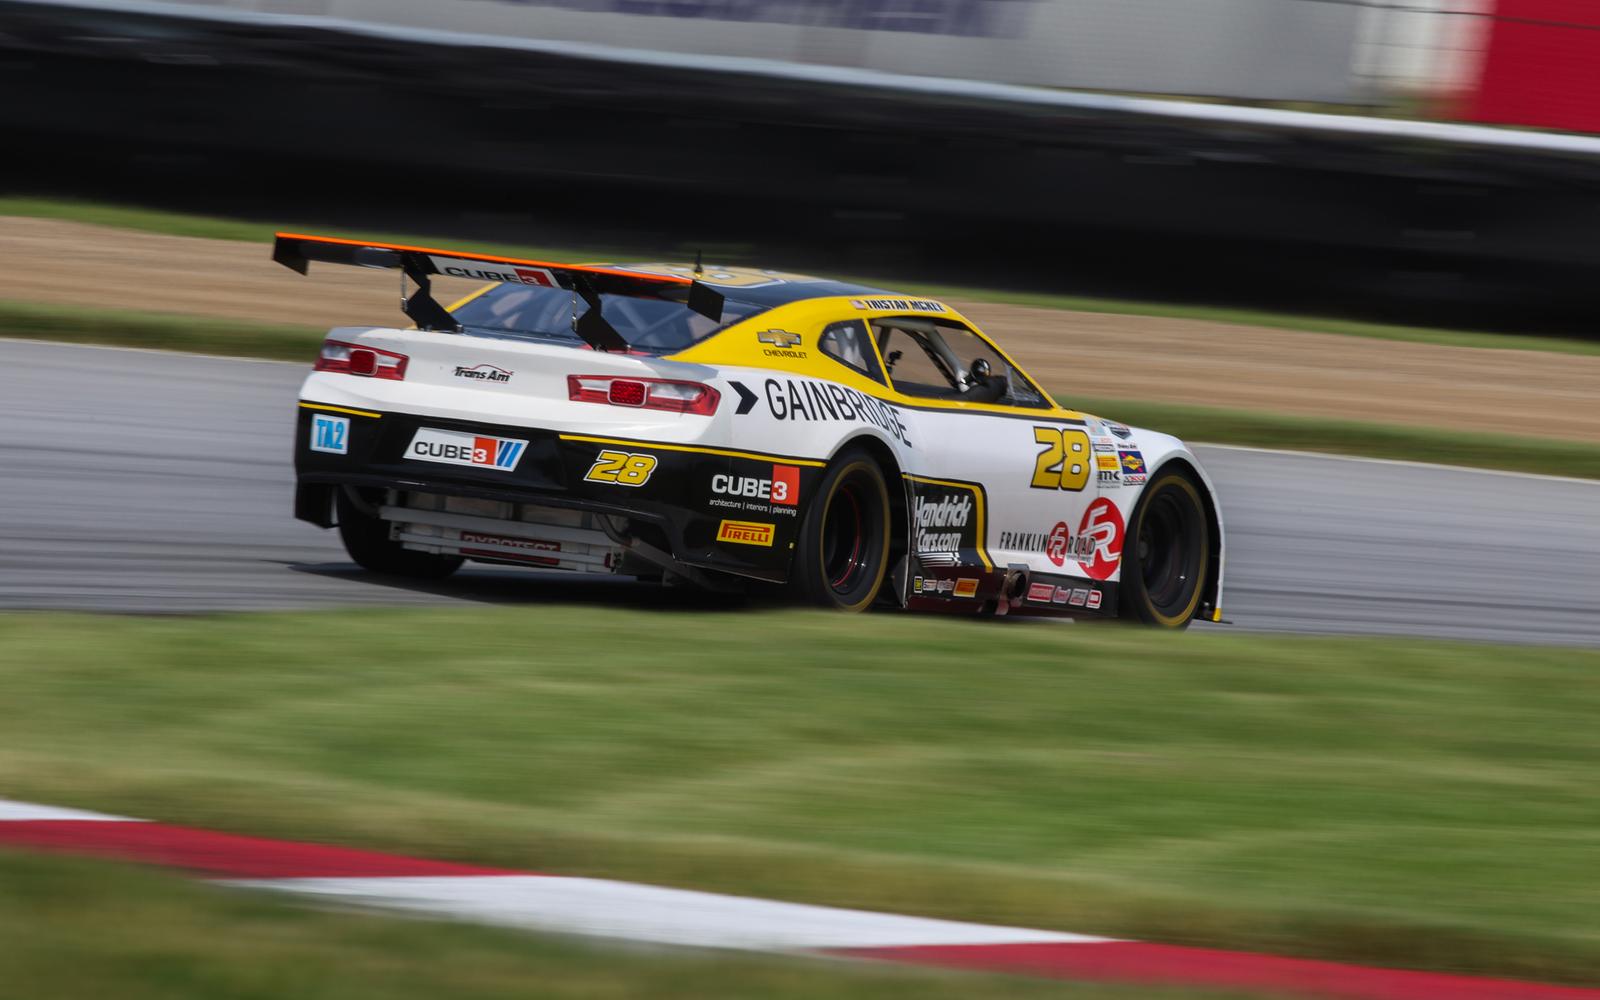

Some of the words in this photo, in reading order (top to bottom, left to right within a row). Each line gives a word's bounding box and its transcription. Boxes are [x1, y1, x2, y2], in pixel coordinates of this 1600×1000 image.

[865, 299, 910, 311] TRISTAN
[764, 349, 808, 359] CHEVROLET
[454, 366, 487, 380] Trans
[486, 370, 511, 382] Am
[765, 379, 912, 448] GAINBRIDGE
[316, 418, 346, 450] TA2
[414, 441, 487, 463] CUBE3
[1030, 426, 1091, 492] 28
[583, 449, 658, 487] 28
[711, 474, 788, 501] CUBE3
[709, 499, 741, 509] architecture
[746, 502, 768, 512] interiors
[772, 506, 797, 517] planning
[913, 495, 972, 538] Hendrick
[721, 523, 771, 543] PIRELLI
[917, 528, 962, 552] Cars.com
[999, 532, 1049, 552] FRANKLIN
[1067, 536, 1096, 555] ROAD
